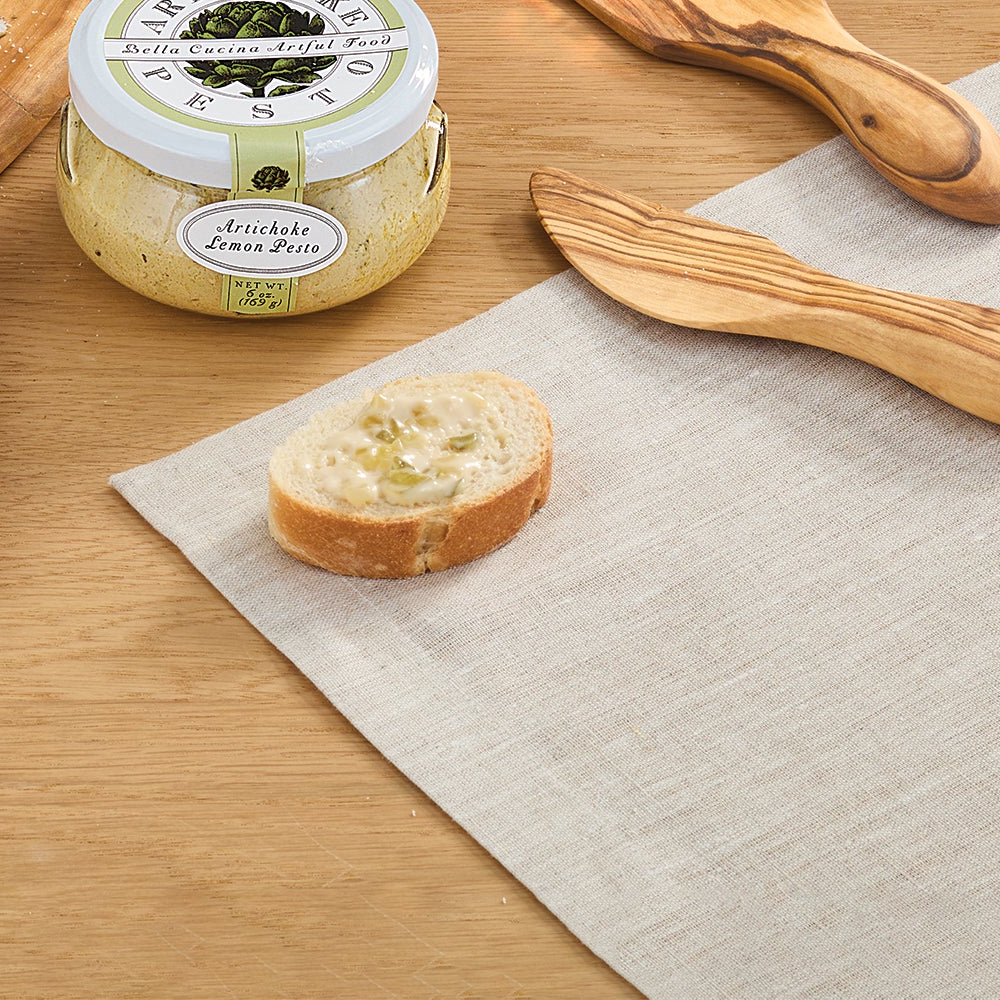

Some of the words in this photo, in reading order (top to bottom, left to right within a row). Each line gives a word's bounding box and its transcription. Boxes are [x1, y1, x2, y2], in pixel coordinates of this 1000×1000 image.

[121, 43, 180, 56] Bella
[189, 42, 260, 55] Cucina
[266, 39, 333, 55] Artful
[342, 34, 392, 50] Food
[141, 59, 374, 120] PESTO
[216, 217, 311, 237] Artichoke
[204, 235, 264, 253] Lemon
[268, 239, 321, 255] Pesto
[235, 280, 262, 290] NET
[265, 281, 288, 291] WT.
[246, 289, 254, 298] 6
[258, 291, 276, 299] oz.
[238, 297, 265, 308] (169
[268, 298, 283, 309] g)
